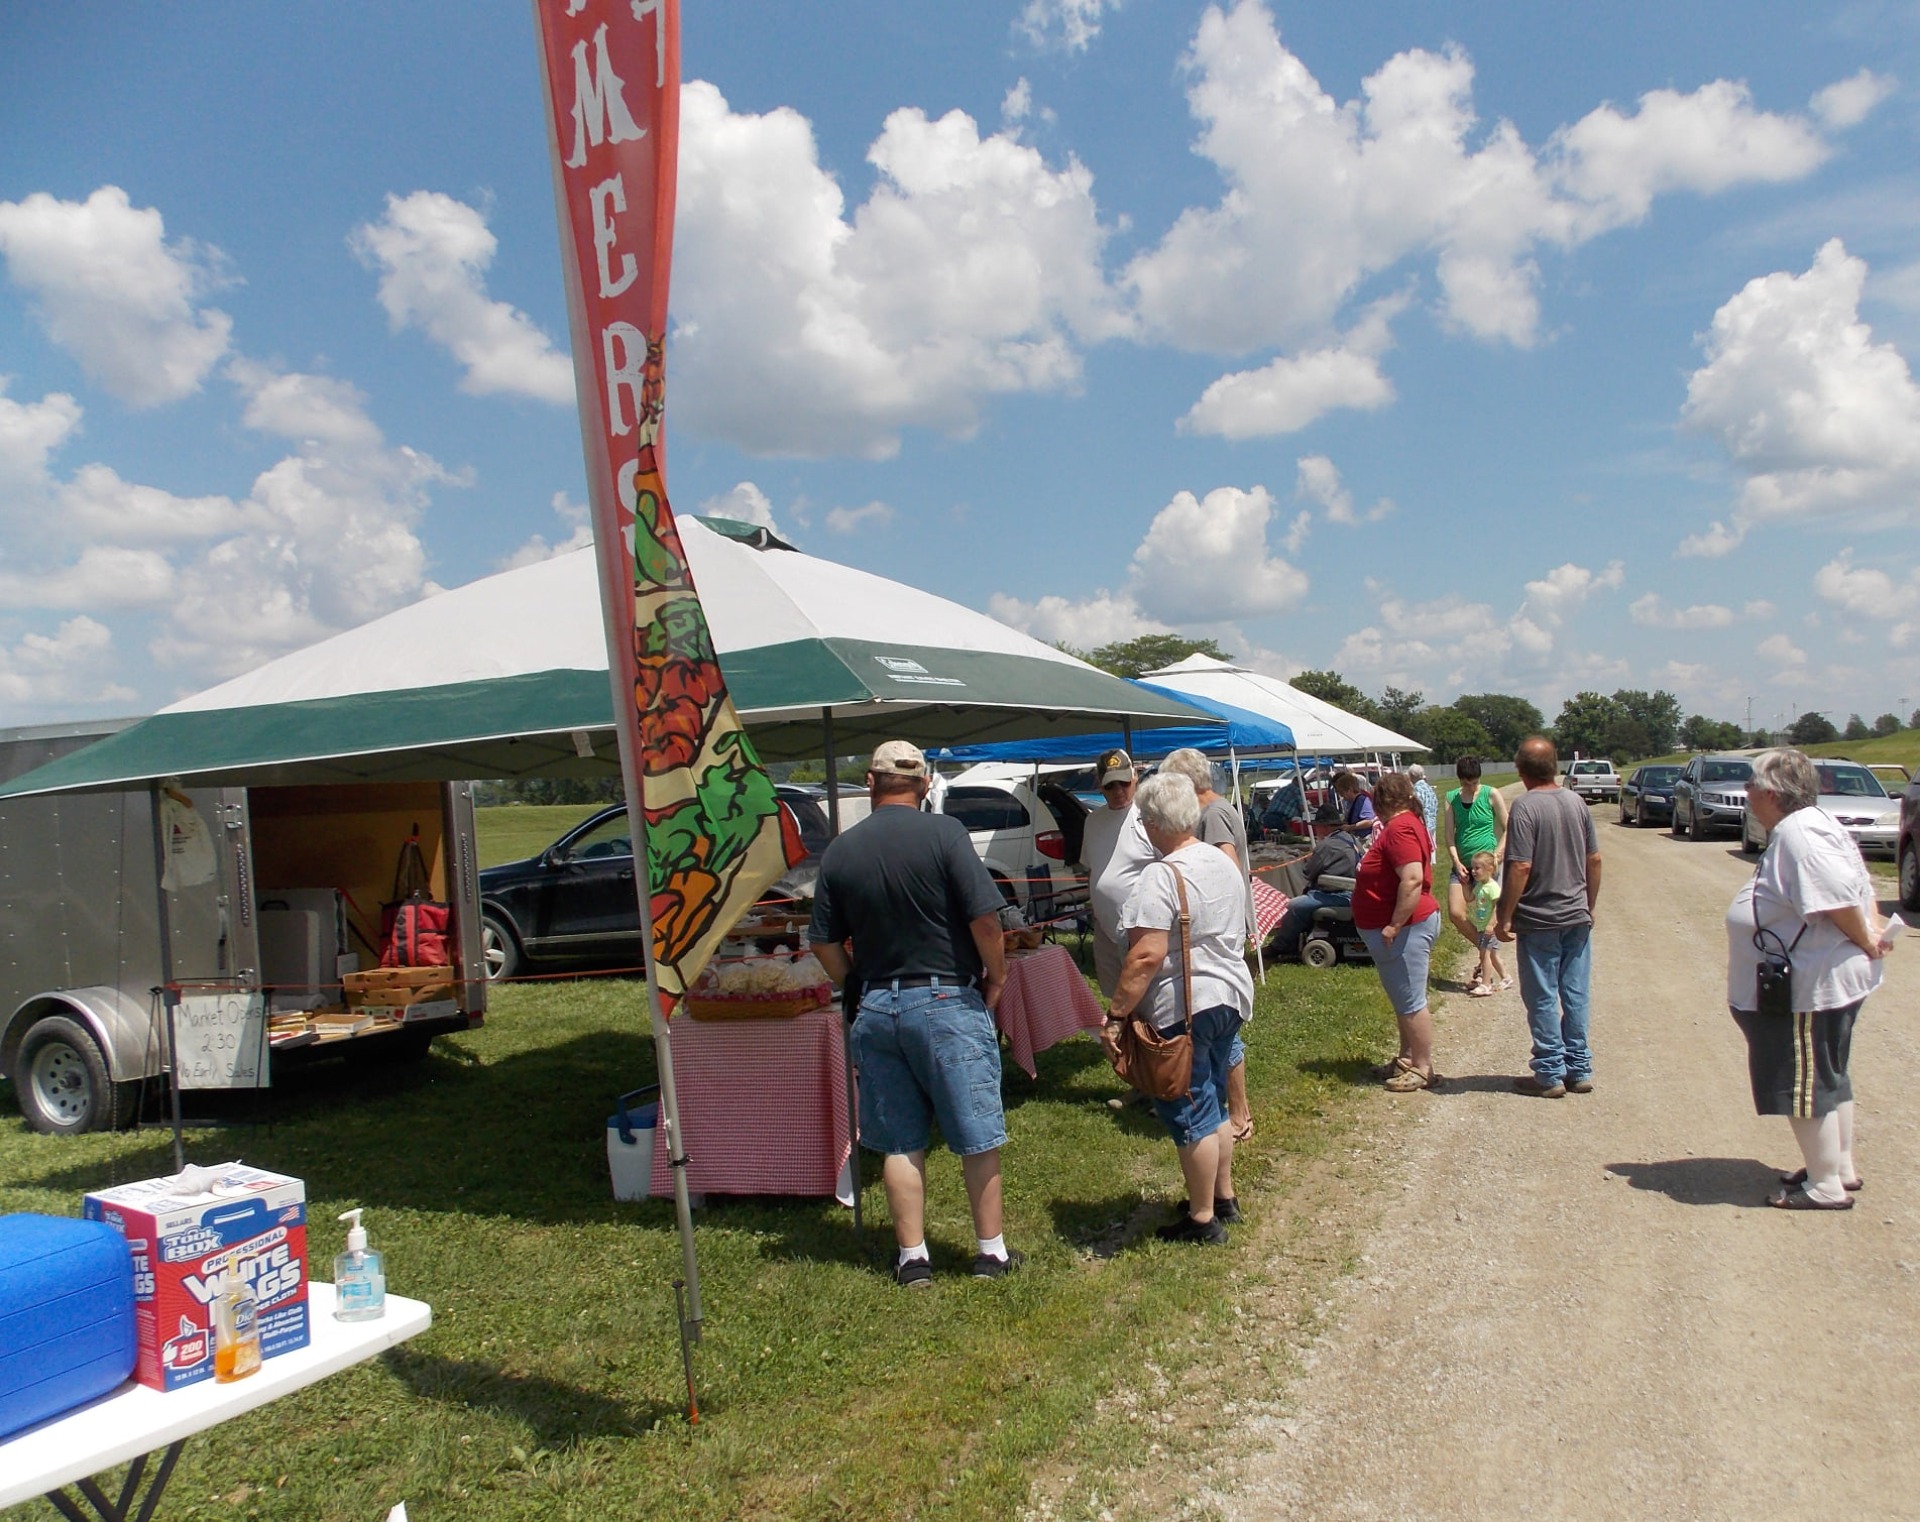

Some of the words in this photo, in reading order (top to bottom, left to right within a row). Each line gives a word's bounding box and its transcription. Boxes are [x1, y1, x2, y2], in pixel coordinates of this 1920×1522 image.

[178, 1002, 224, 1027] Market
[193, 1062, 218, 1079] Early
[225, 1061, 256, 1078] Sales
[167, 1236, 221, 1260] BOX
[206, 1229, 285, 1271] PROESSIONAL
[181, 1340, 203, 1355] 200
